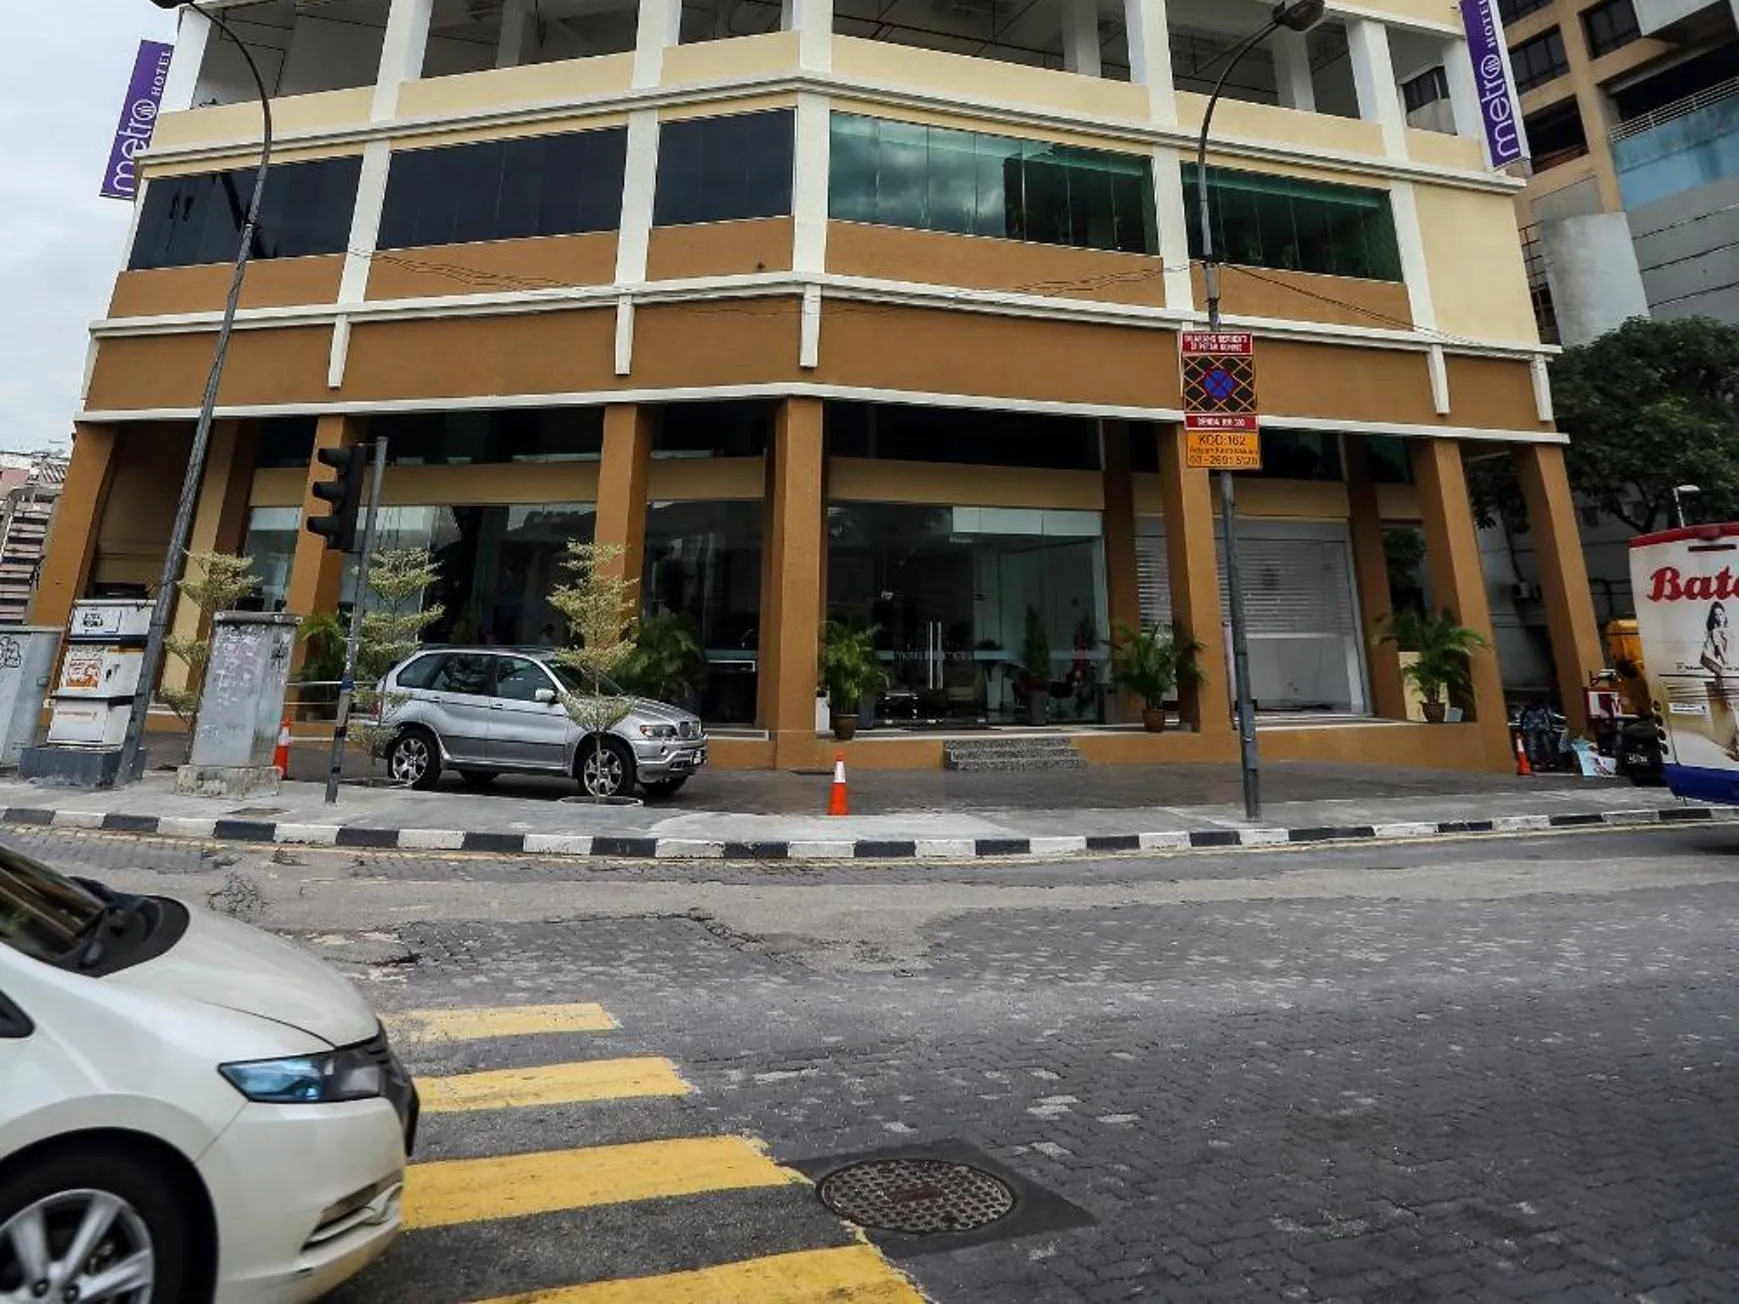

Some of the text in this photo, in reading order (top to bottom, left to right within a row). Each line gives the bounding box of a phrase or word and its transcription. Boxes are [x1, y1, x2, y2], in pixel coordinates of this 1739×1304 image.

[113, 49, 172, 192] metro HOTEL
[1480, 54, 1519, 157] metro
[1646, 565, 1739, 602] Bat
